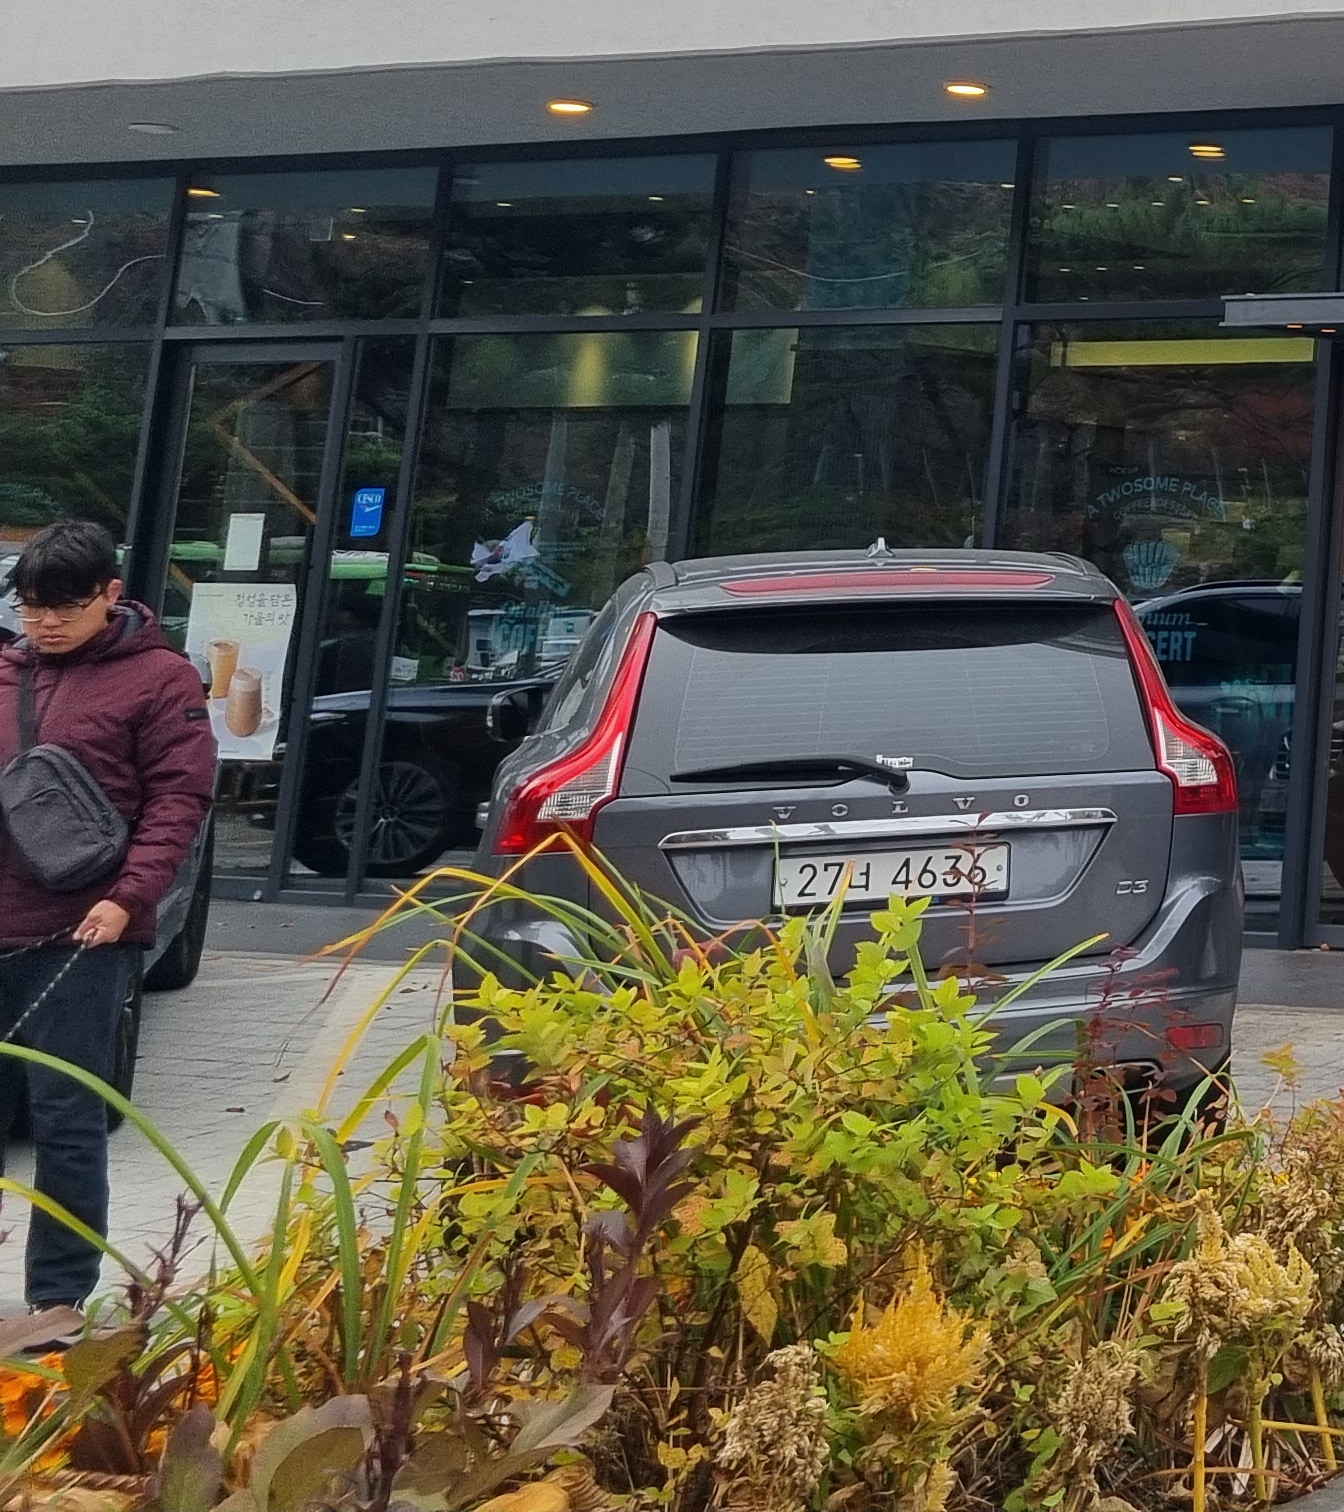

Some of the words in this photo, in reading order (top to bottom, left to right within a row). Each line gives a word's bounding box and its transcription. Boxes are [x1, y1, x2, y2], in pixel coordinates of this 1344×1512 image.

[1096, 476, 1180, 508] TWOSOME
[235, 592, 268, 608] 정성을
[270, 592, 293, 608] 담은
[243, 612, 276, 626] 가을의
[278, 612, 292, 626] 맛
[771, 793, 1030, 820] VOLVO
[1116, 879, 1150, 896] D3
